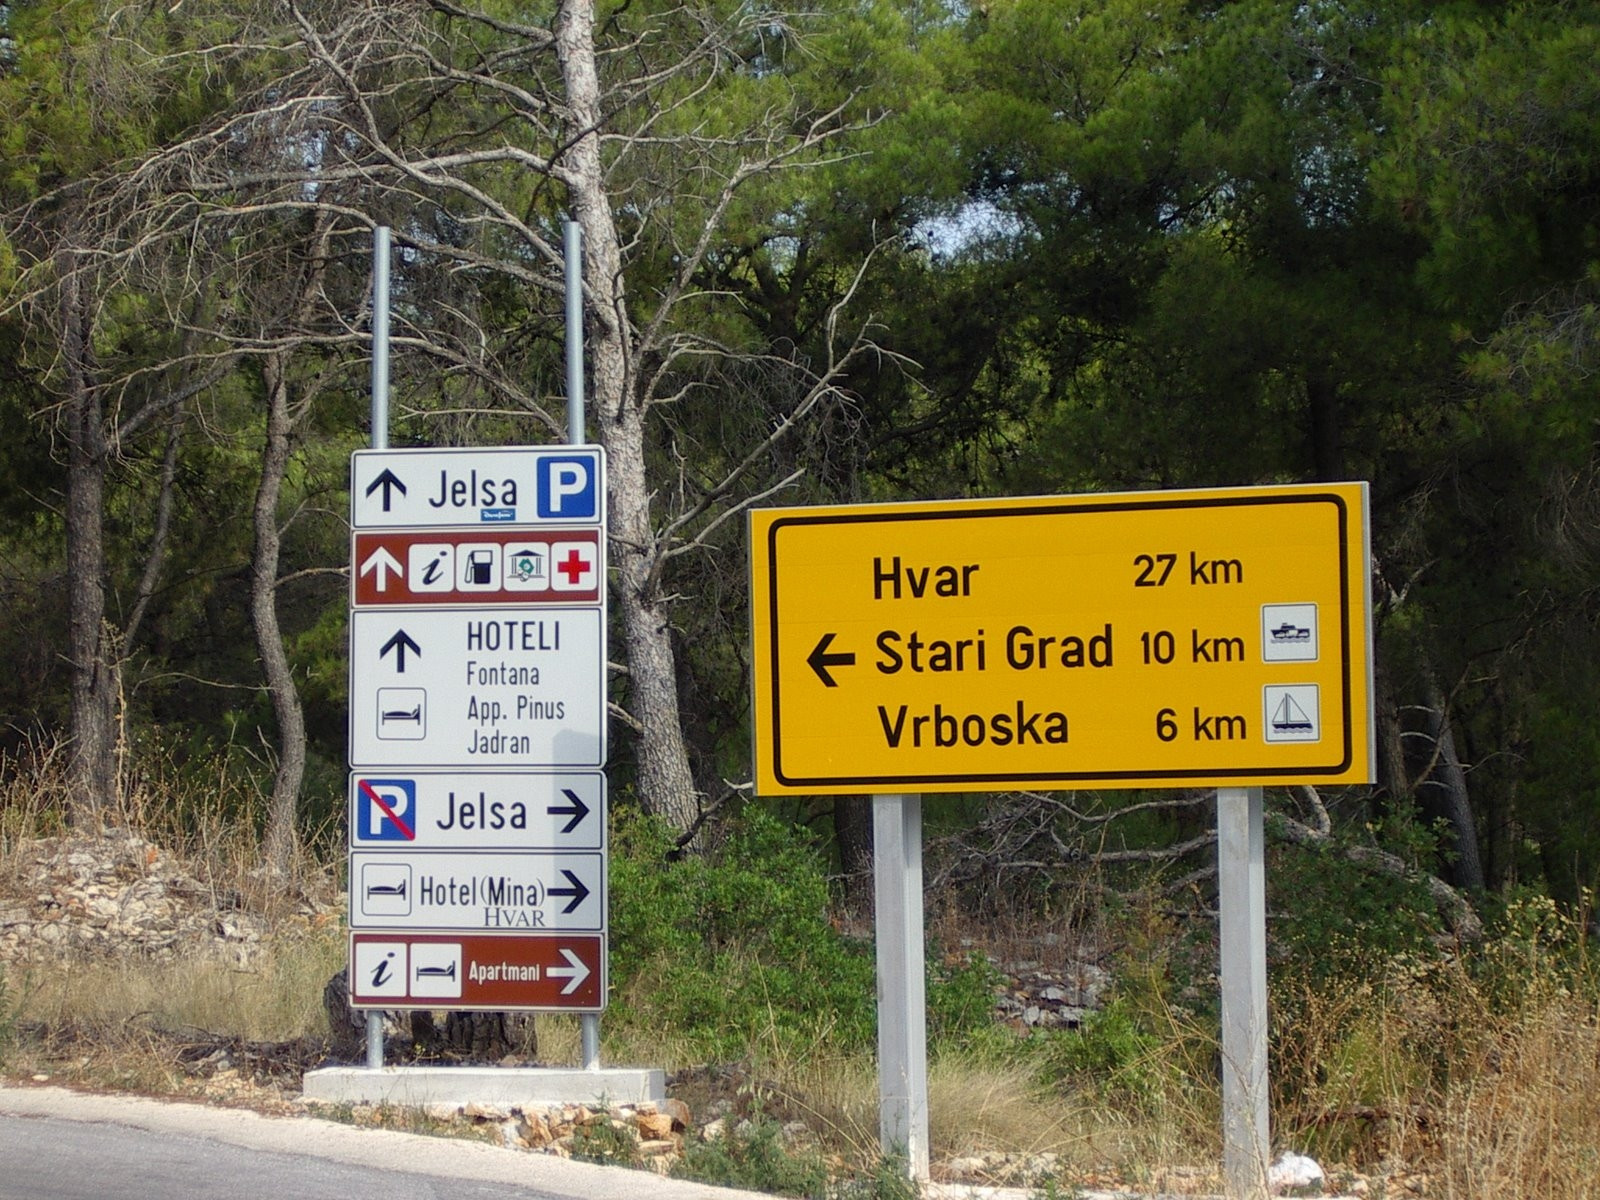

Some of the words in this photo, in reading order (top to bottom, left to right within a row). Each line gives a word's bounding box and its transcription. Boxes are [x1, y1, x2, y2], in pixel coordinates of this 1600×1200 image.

[428, 469, 517, 508] Jelsa
[549, 461, 588, 513] P
[873, 556, 980, 600] Hvar
[1133, 553, 1177, 587] 27
[1190, 551, 1243, 585] km
[467, 620, 560, 651] HOTELI
[876, 629, 986, 675] Stari
[1006, 623, 1113, 671] Grad
[1140, 630, 1175, 665] 10
[1192, 628, 1245, 663] km
[467, 660, 540, 686] Fontana
[467, 695, 507, 727] App.
[517, 694, 565, 720] Pinus
[877, 700, 1069, 748] Vrboska
[1156, 708, 1178, 742] 6
[1193, 706, 1247, 741] km
[467, 729, 530, 755] Jadran
[369, 785, 409, 835] P
[436, 792, 527, 830] Jelsa
[468, 960, 540, 985] Apartmani
